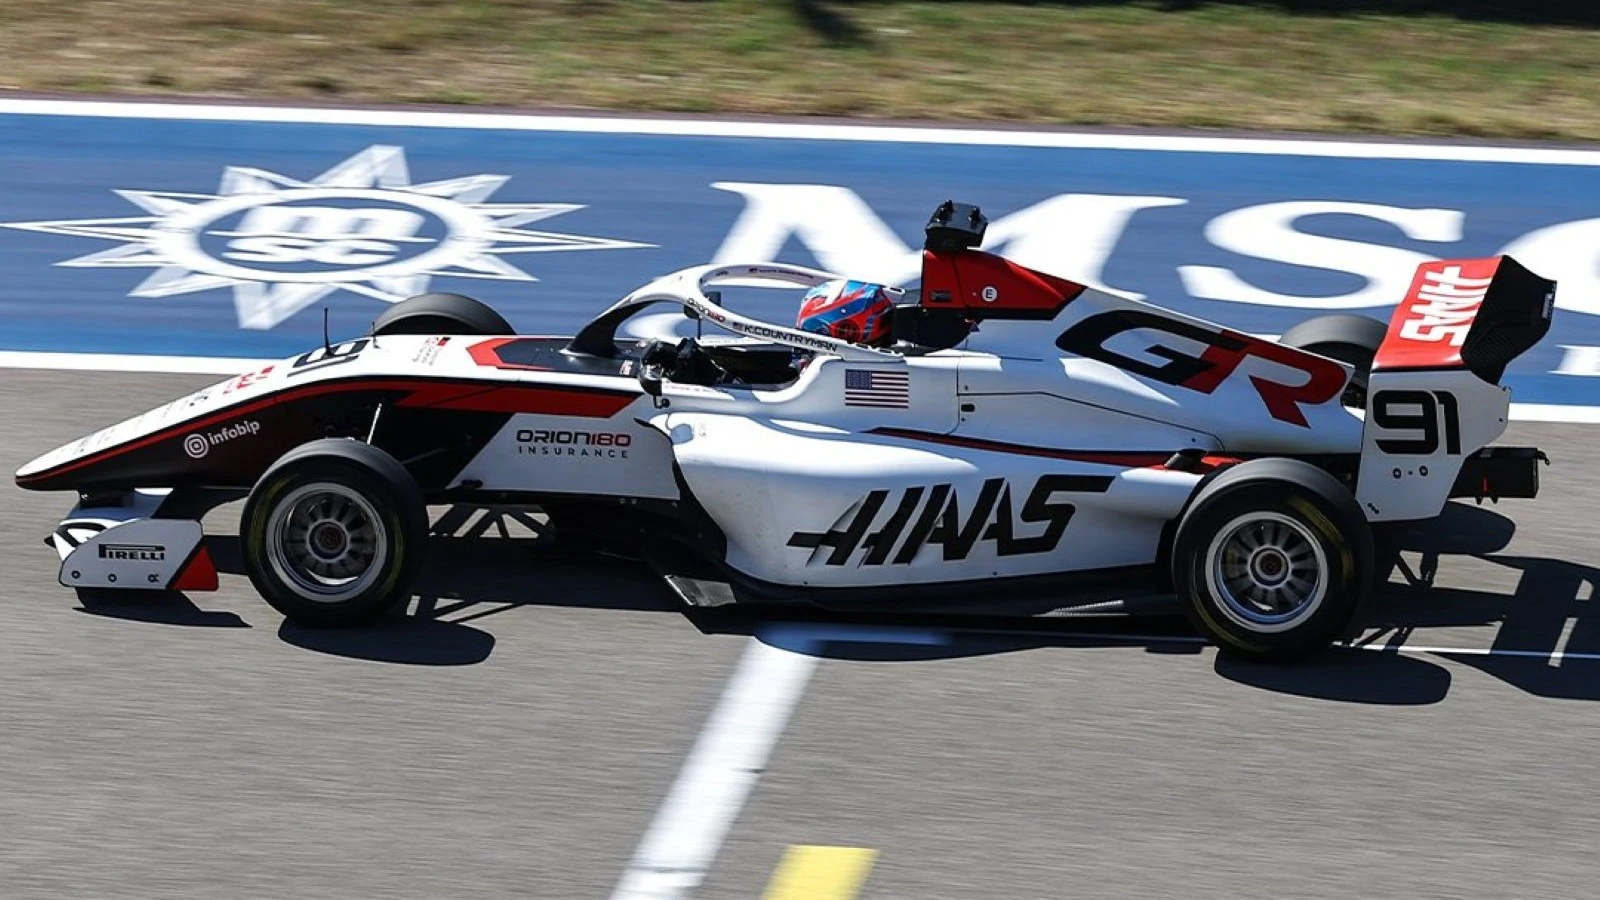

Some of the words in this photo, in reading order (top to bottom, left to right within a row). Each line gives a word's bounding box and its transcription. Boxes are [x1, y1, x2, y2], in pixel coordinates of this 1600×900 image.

[985, 288, 994, 300] E
[1400, 266, 1494, 347] HAAS
[1055, 309, 1349, 429] GR
[207, 420, 261, 446] infobip
[1372, 390, 1462, 456] 91
[516, 429, 632, 447] ORION180
[518, 446, 629, 459] INSURANCE
[786, 474, 1116, 569] HAAS
[98, 543, 166, 560] PIRELLI
